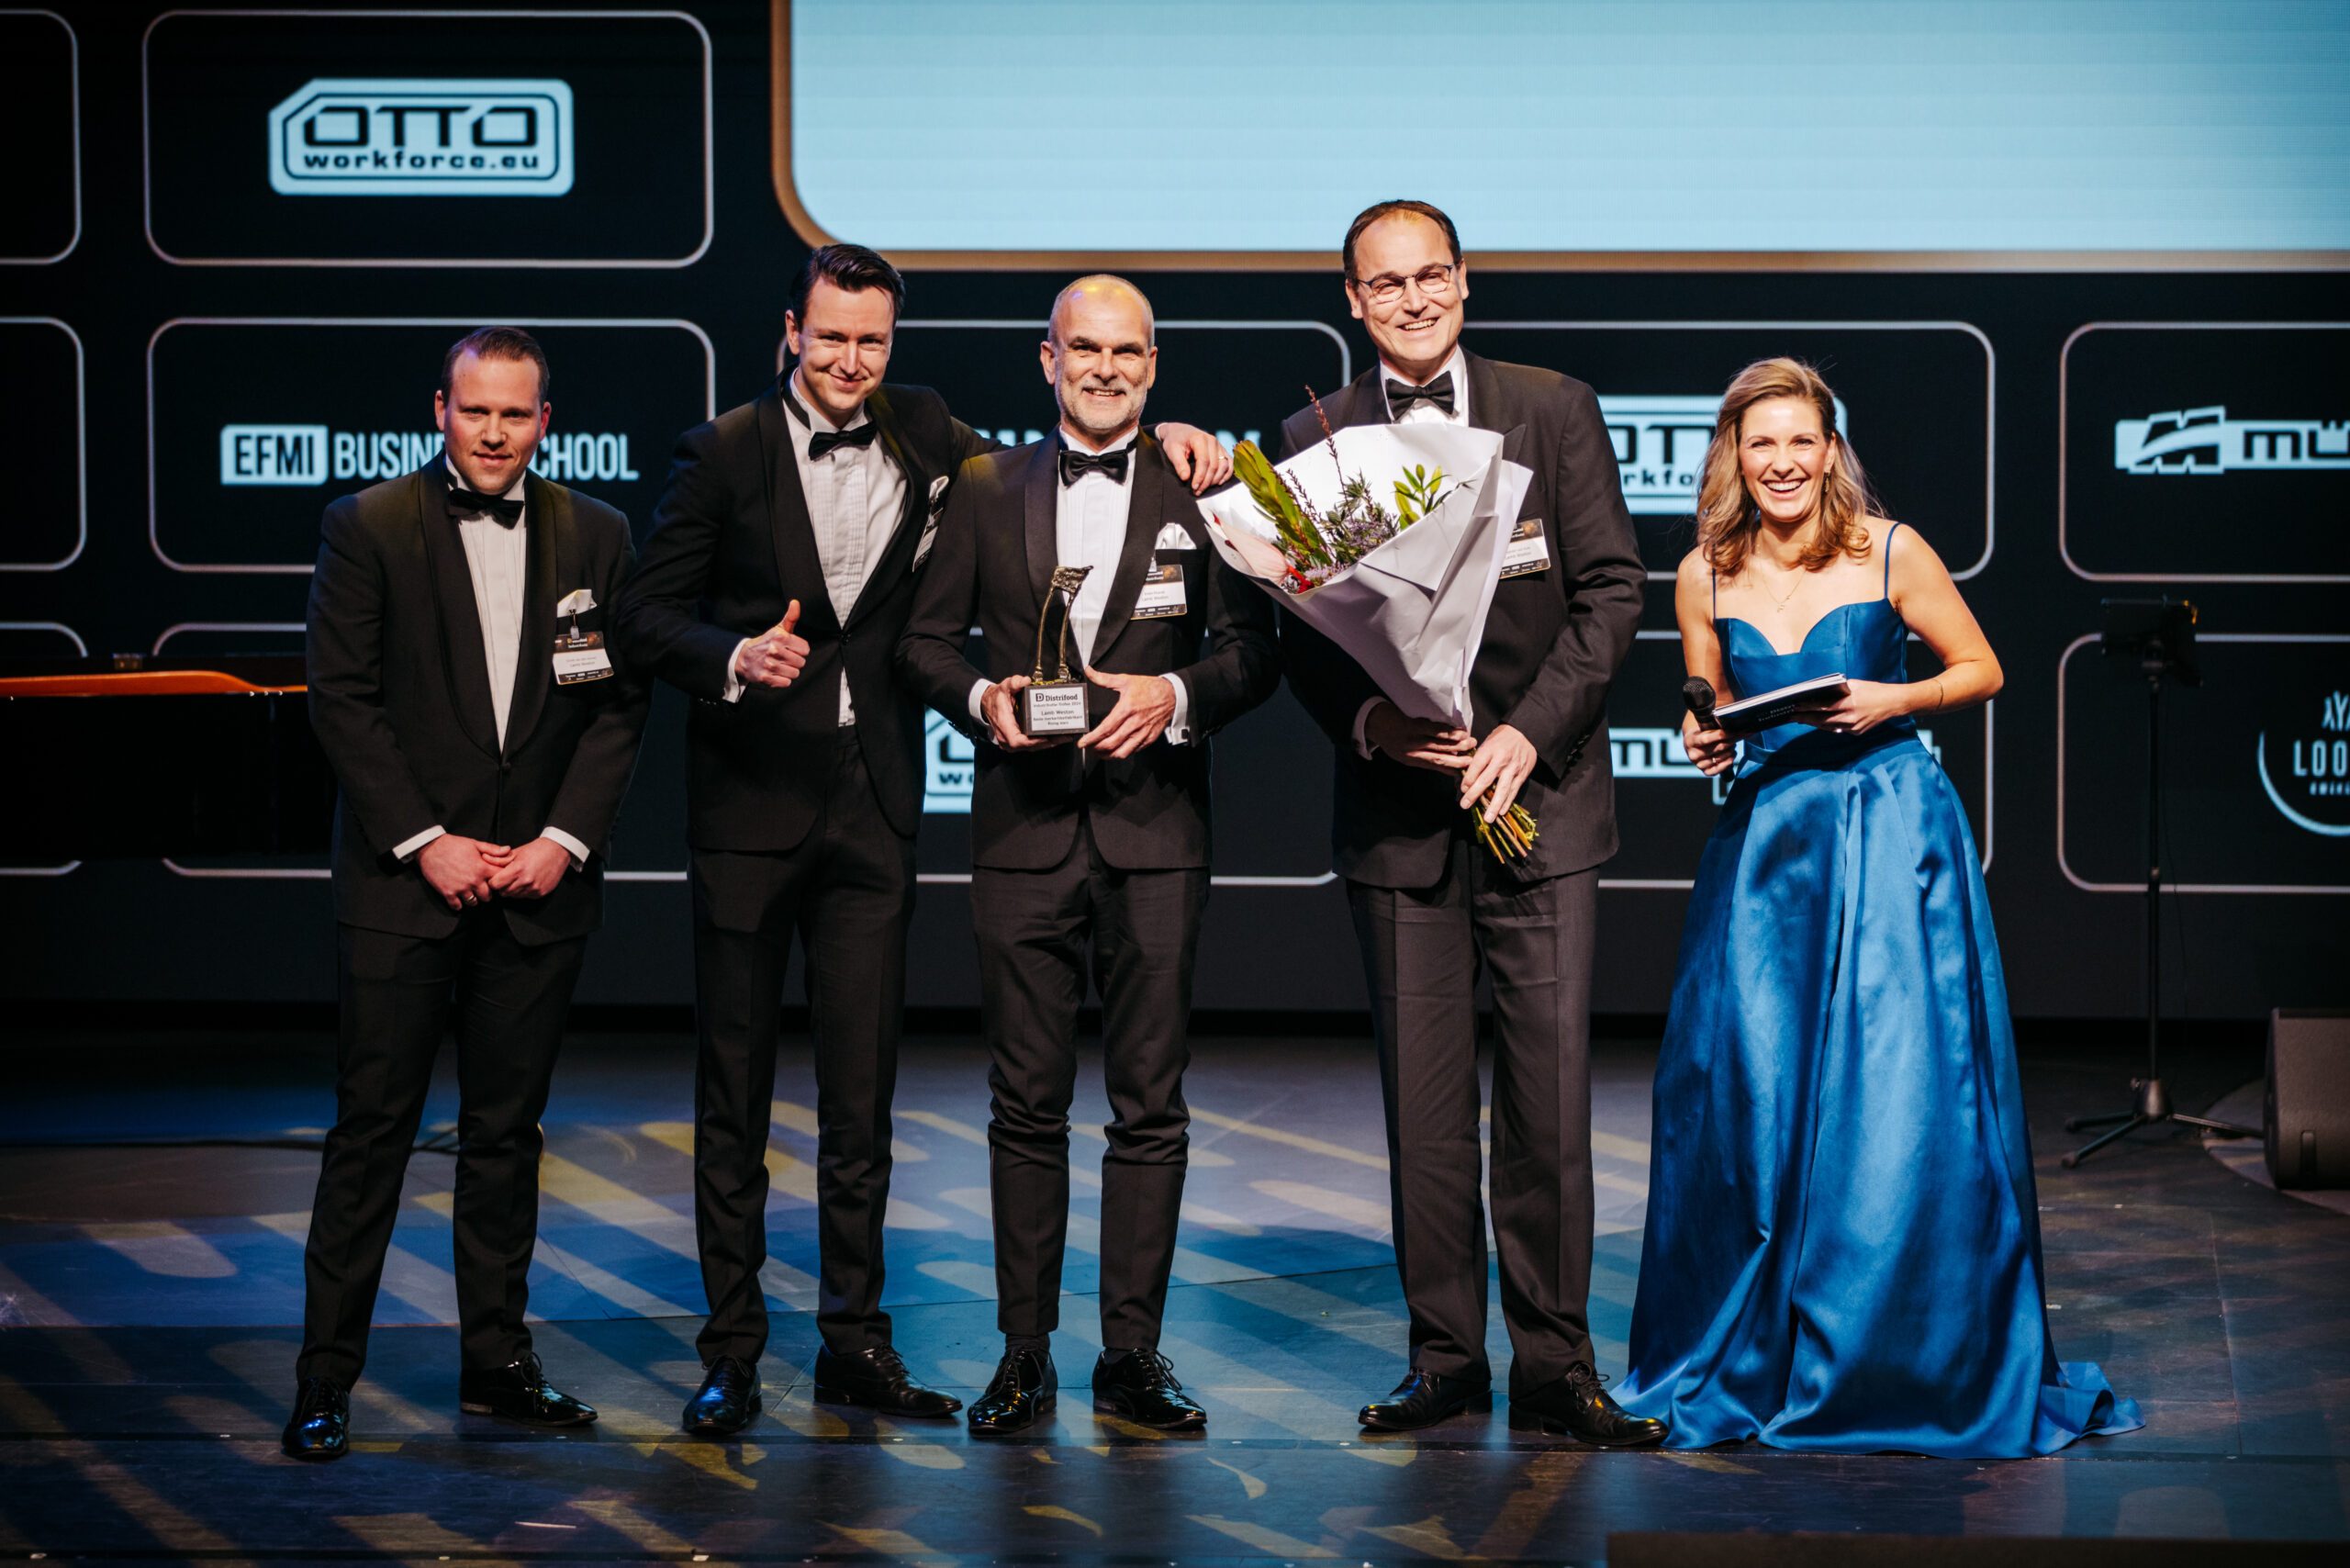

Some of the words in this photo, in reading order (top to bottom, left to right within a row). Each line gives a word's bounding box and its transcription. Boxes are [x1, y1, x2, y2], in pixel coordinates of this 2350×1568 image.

[303, 105, 538, 148] OTTO
[304, 150, 539, 169] workforce.eu
[234, 433, 314, 476] EFMI
[333, 431, 445, 479] BUSIN
[527, 432, 640, 481] CHOOL
